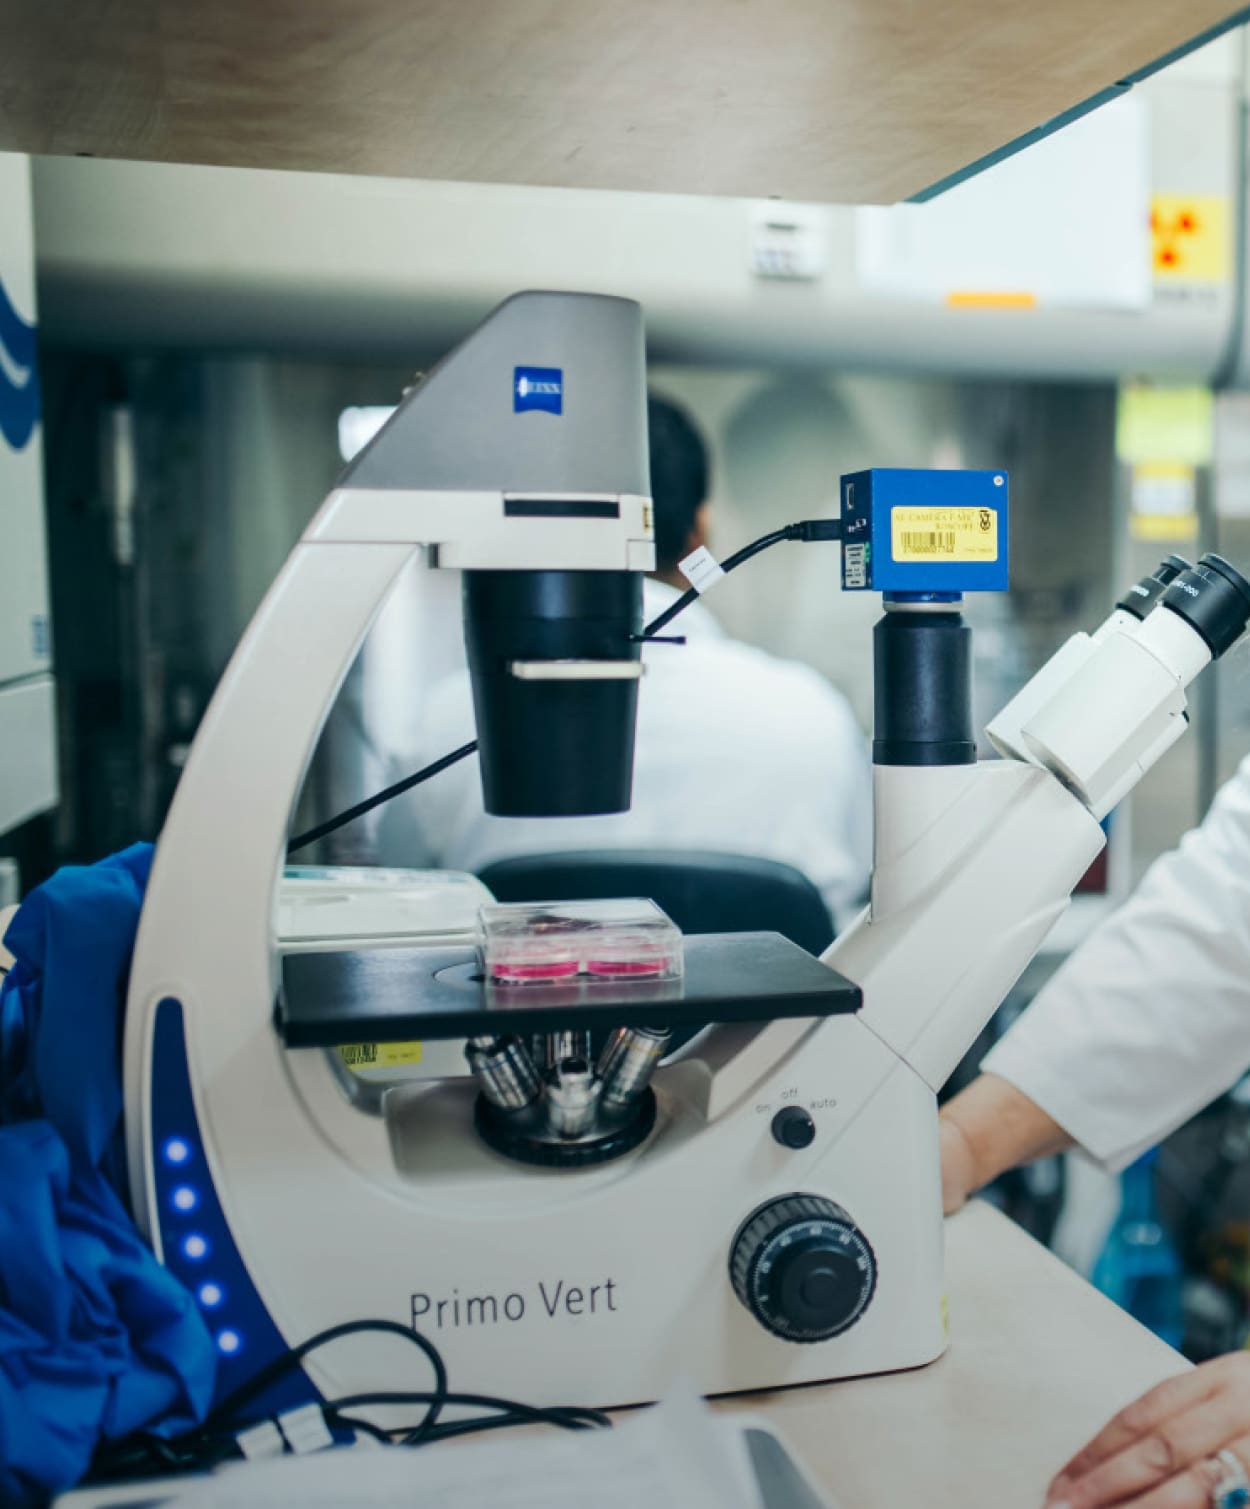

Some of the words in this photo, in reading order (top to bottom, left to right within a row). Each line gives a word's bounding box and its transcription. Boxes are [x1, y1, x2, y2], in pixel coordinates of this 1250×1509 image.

[810, 1099, 837, 1110] auto
[411, 1287, 525, 1331] Primo
[538, 1278, 617, 1318] Vert
